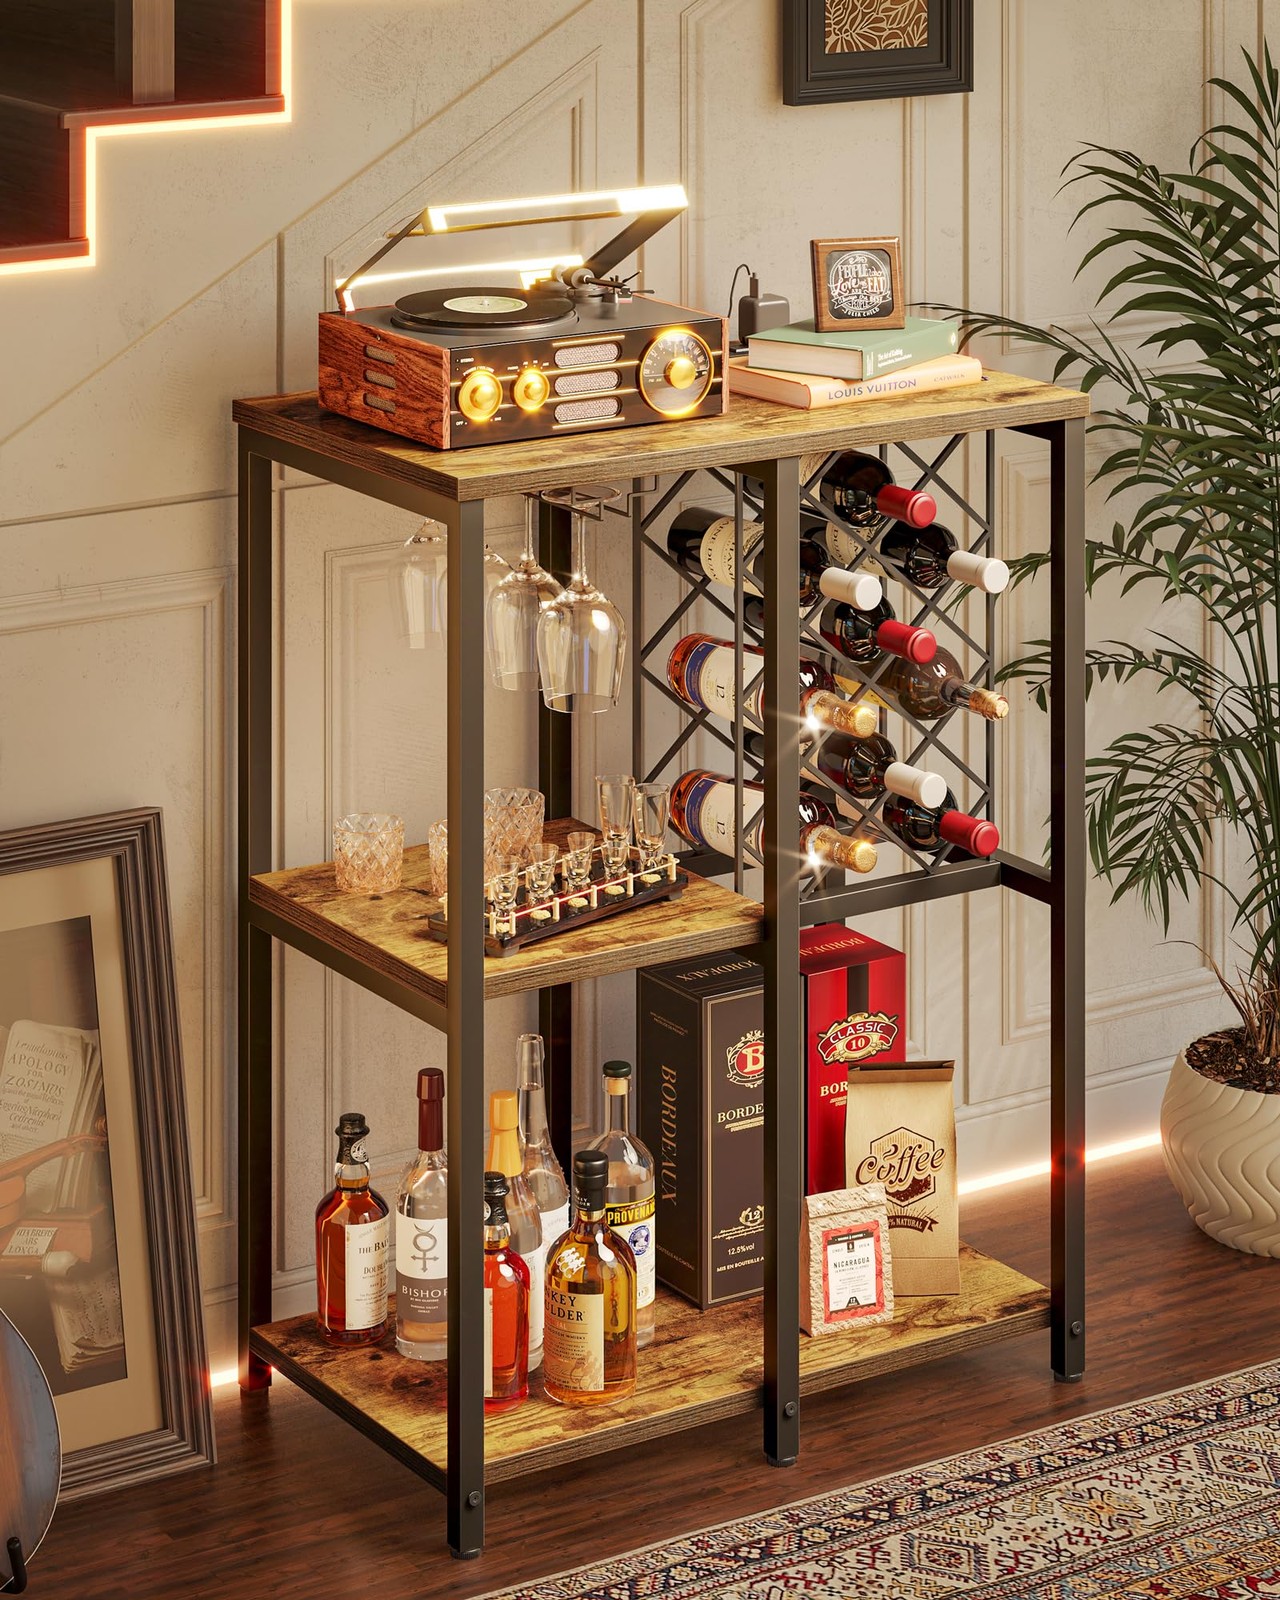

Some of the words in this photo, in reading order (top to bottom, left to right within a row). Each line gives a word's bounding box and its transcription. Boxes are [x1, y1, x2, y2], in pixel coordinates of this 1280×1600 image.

[867, 276, 885, 293] EAT
[828, 387, 863, 400] LOUIS
[867, 379, 917, 394] VUITTON
[933, 374, 966, 383] CATWALK
[716, 684, 725, 699] 12
[716, 820, 726, 836] 12
[829, 1022, 886, 1044] CLASSIC
[850, 1037, 866, 1050] 10
[661, 1064, 677, 1206] BORDEAUX
[855, 1143, 945, 1185] Coffee
[747, 1209, 761, 1222] 12
[896, 1218, 923, 1230] NATURAL
[728, 1242, 755, 1256] 12.5%vol
[716, 1265, 726, 1273] MIS
[833, 1256, 870, 1269] NICARAGUA
